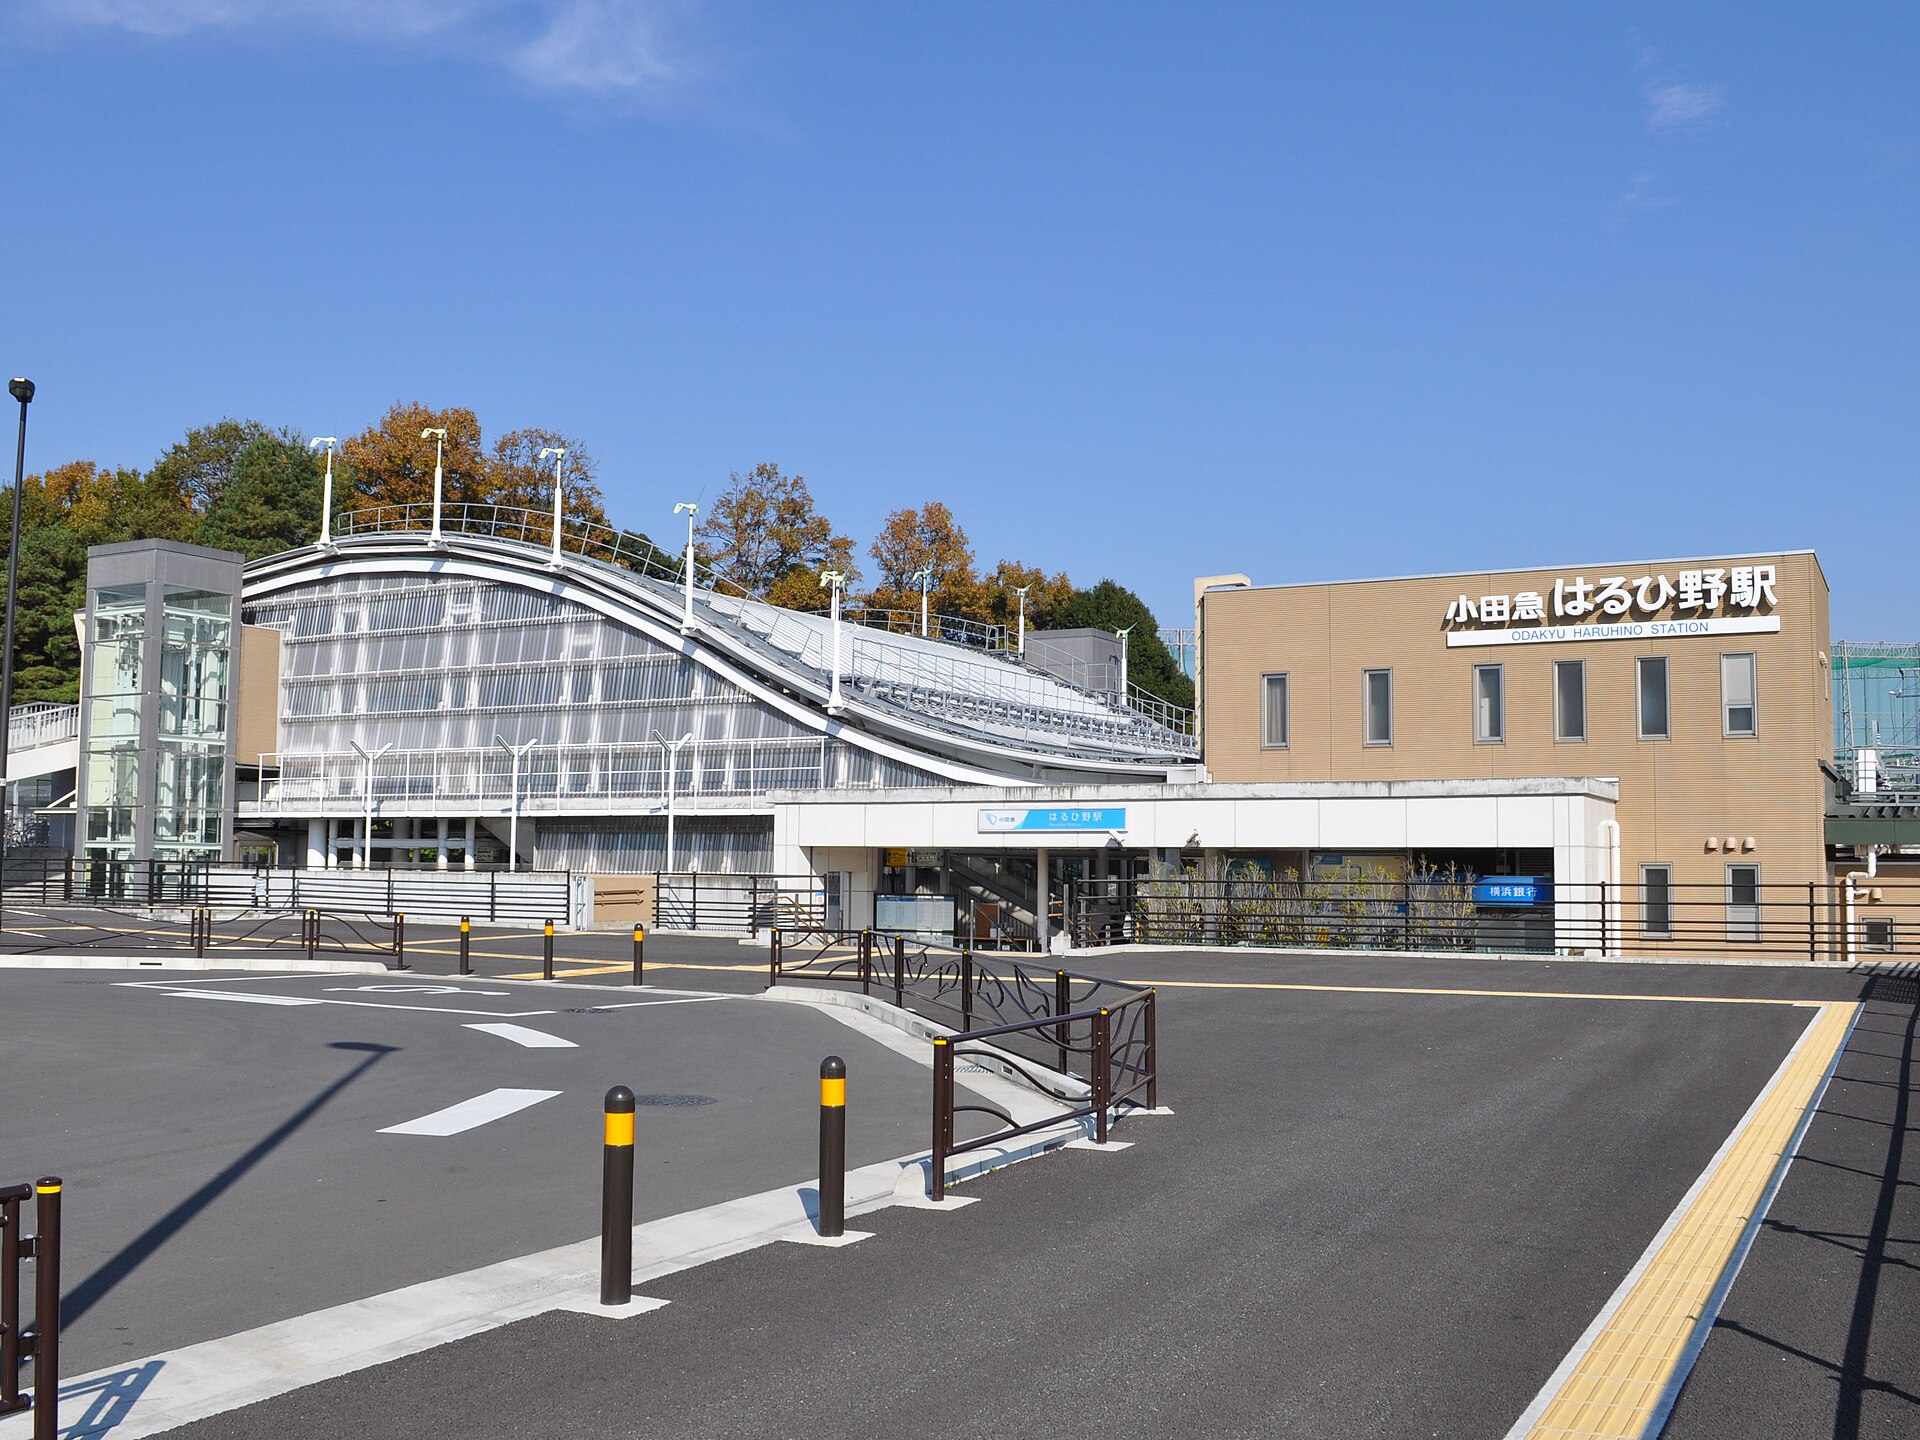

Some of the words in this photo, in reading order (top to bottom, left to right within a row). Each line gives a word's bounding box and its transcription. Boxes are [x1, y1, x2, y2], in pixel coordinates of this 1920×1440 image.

[1446, 592, 1546, 622] 小田急
[1554, 565, 1779, 617] はるひ野駅
[1511, 628, 1566, 642] ODAKYU
[1573, 624, 1644, 638] HARUHINO
[1650, 621, 1709, 635] STATION
[1049, 811, 1102, 821] はるひ野駅
[1489, 887, 1538, 897] 横浜銀行
